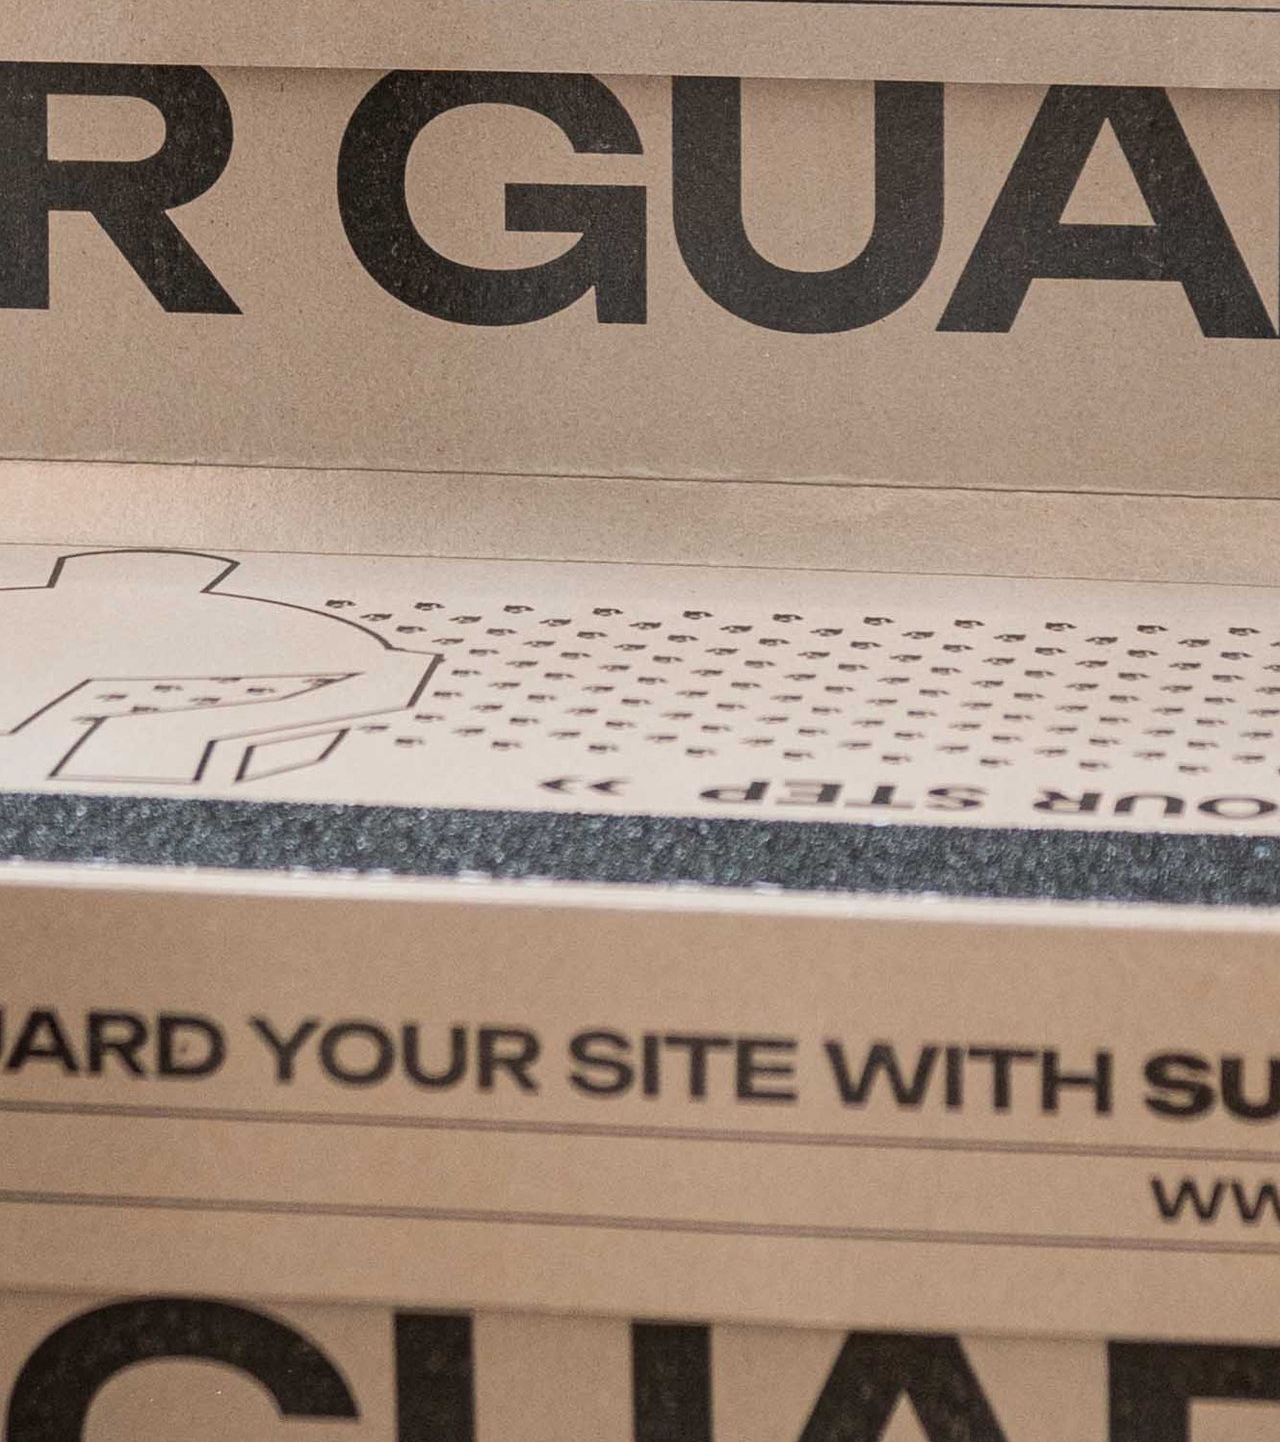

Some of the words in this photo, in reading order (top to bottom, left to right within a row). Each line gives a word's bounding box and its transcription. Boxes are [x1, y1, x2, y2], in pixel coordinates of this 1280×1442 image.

[694, 778, 990, 816] STEP
[249, 1016, 540, 1091] YOUR
[569, 1030, 797, 1103] SITE
[824, 1040, 1112, 1115] WITH
